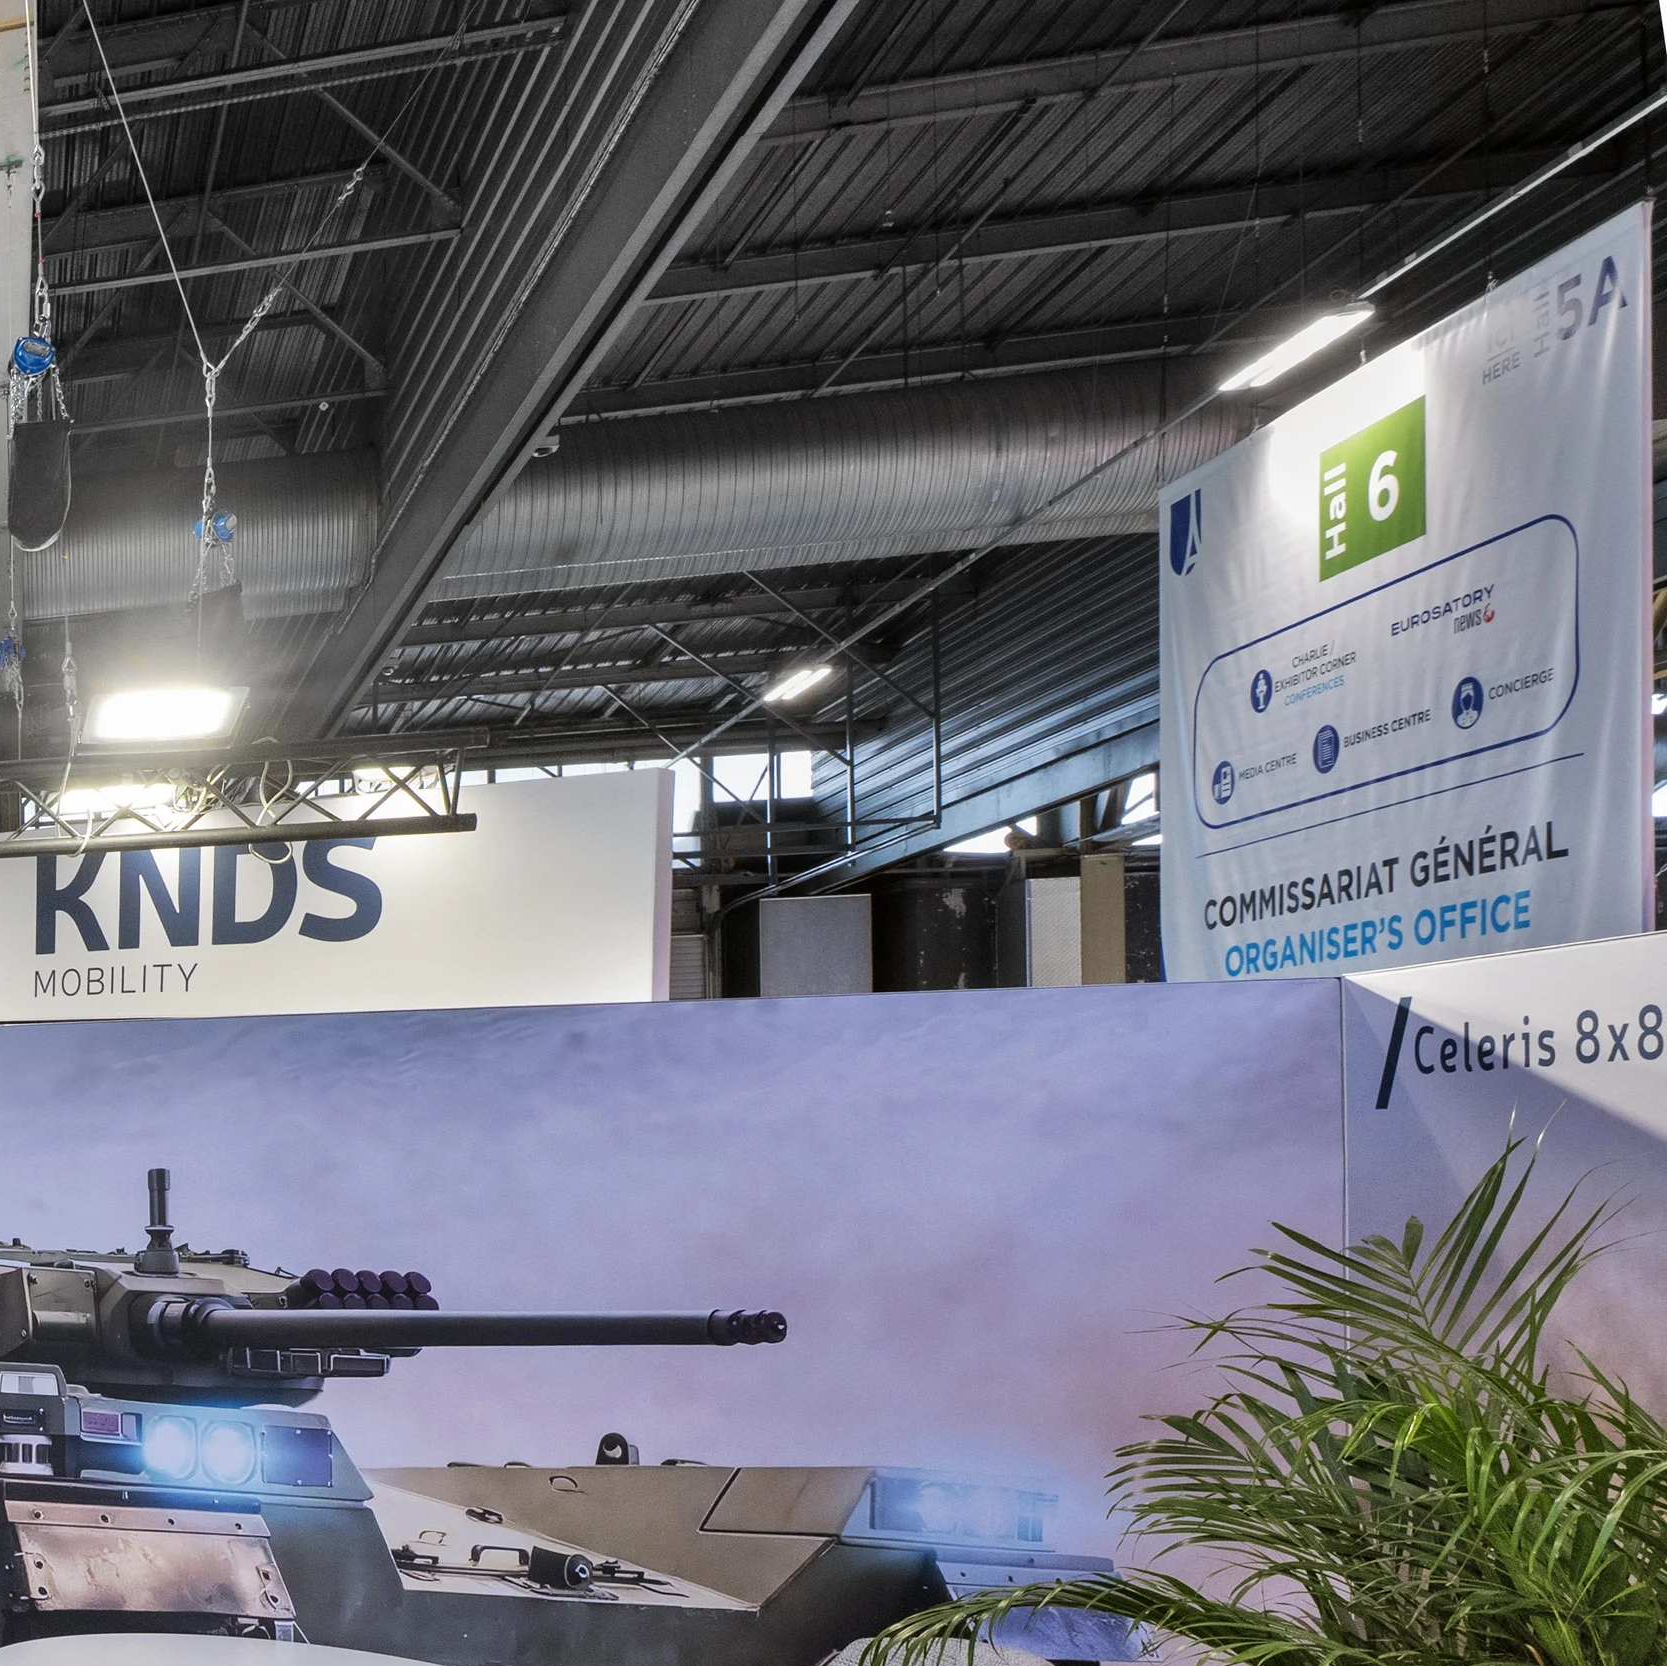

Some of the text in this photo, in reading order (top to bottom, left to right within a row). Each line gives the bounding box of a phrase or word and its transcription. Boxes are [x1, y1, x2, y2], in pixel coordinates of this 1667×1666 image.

[1556, 255, 1629, 341] 5A
[1482, 352, 1521, 386] HERE
[1323, 450, 1400, 561] Hall 6
[1391, 584, 1495, 636] EUROSATORY
[1453, 609, 1482, 634] news
[1274, 651, 1357, 693] EXHIBITOR CORNER
[1292, 645, 1328, 669] CHARLIE
[1284, 675, 1345, 706] CONFERENCES
[1488, 668, 1554, 700] CONCIERGE
[1343, 709, 1432, 749] BUSINESS CENTRE
[1238, 753, 1298, 782] MEDIA CENTRE
[35, 836, 383, 955] KNDS
[1204, 821, 1570, 931] COMMISSARIAT GÉNÉRAL
[1225, 890, 1532, 978] ORGANISER'S OFFICE
[34, 962, 199, 998] MOBILITY
[1414, 1003, 1665, 1075] Celeris 8x8
